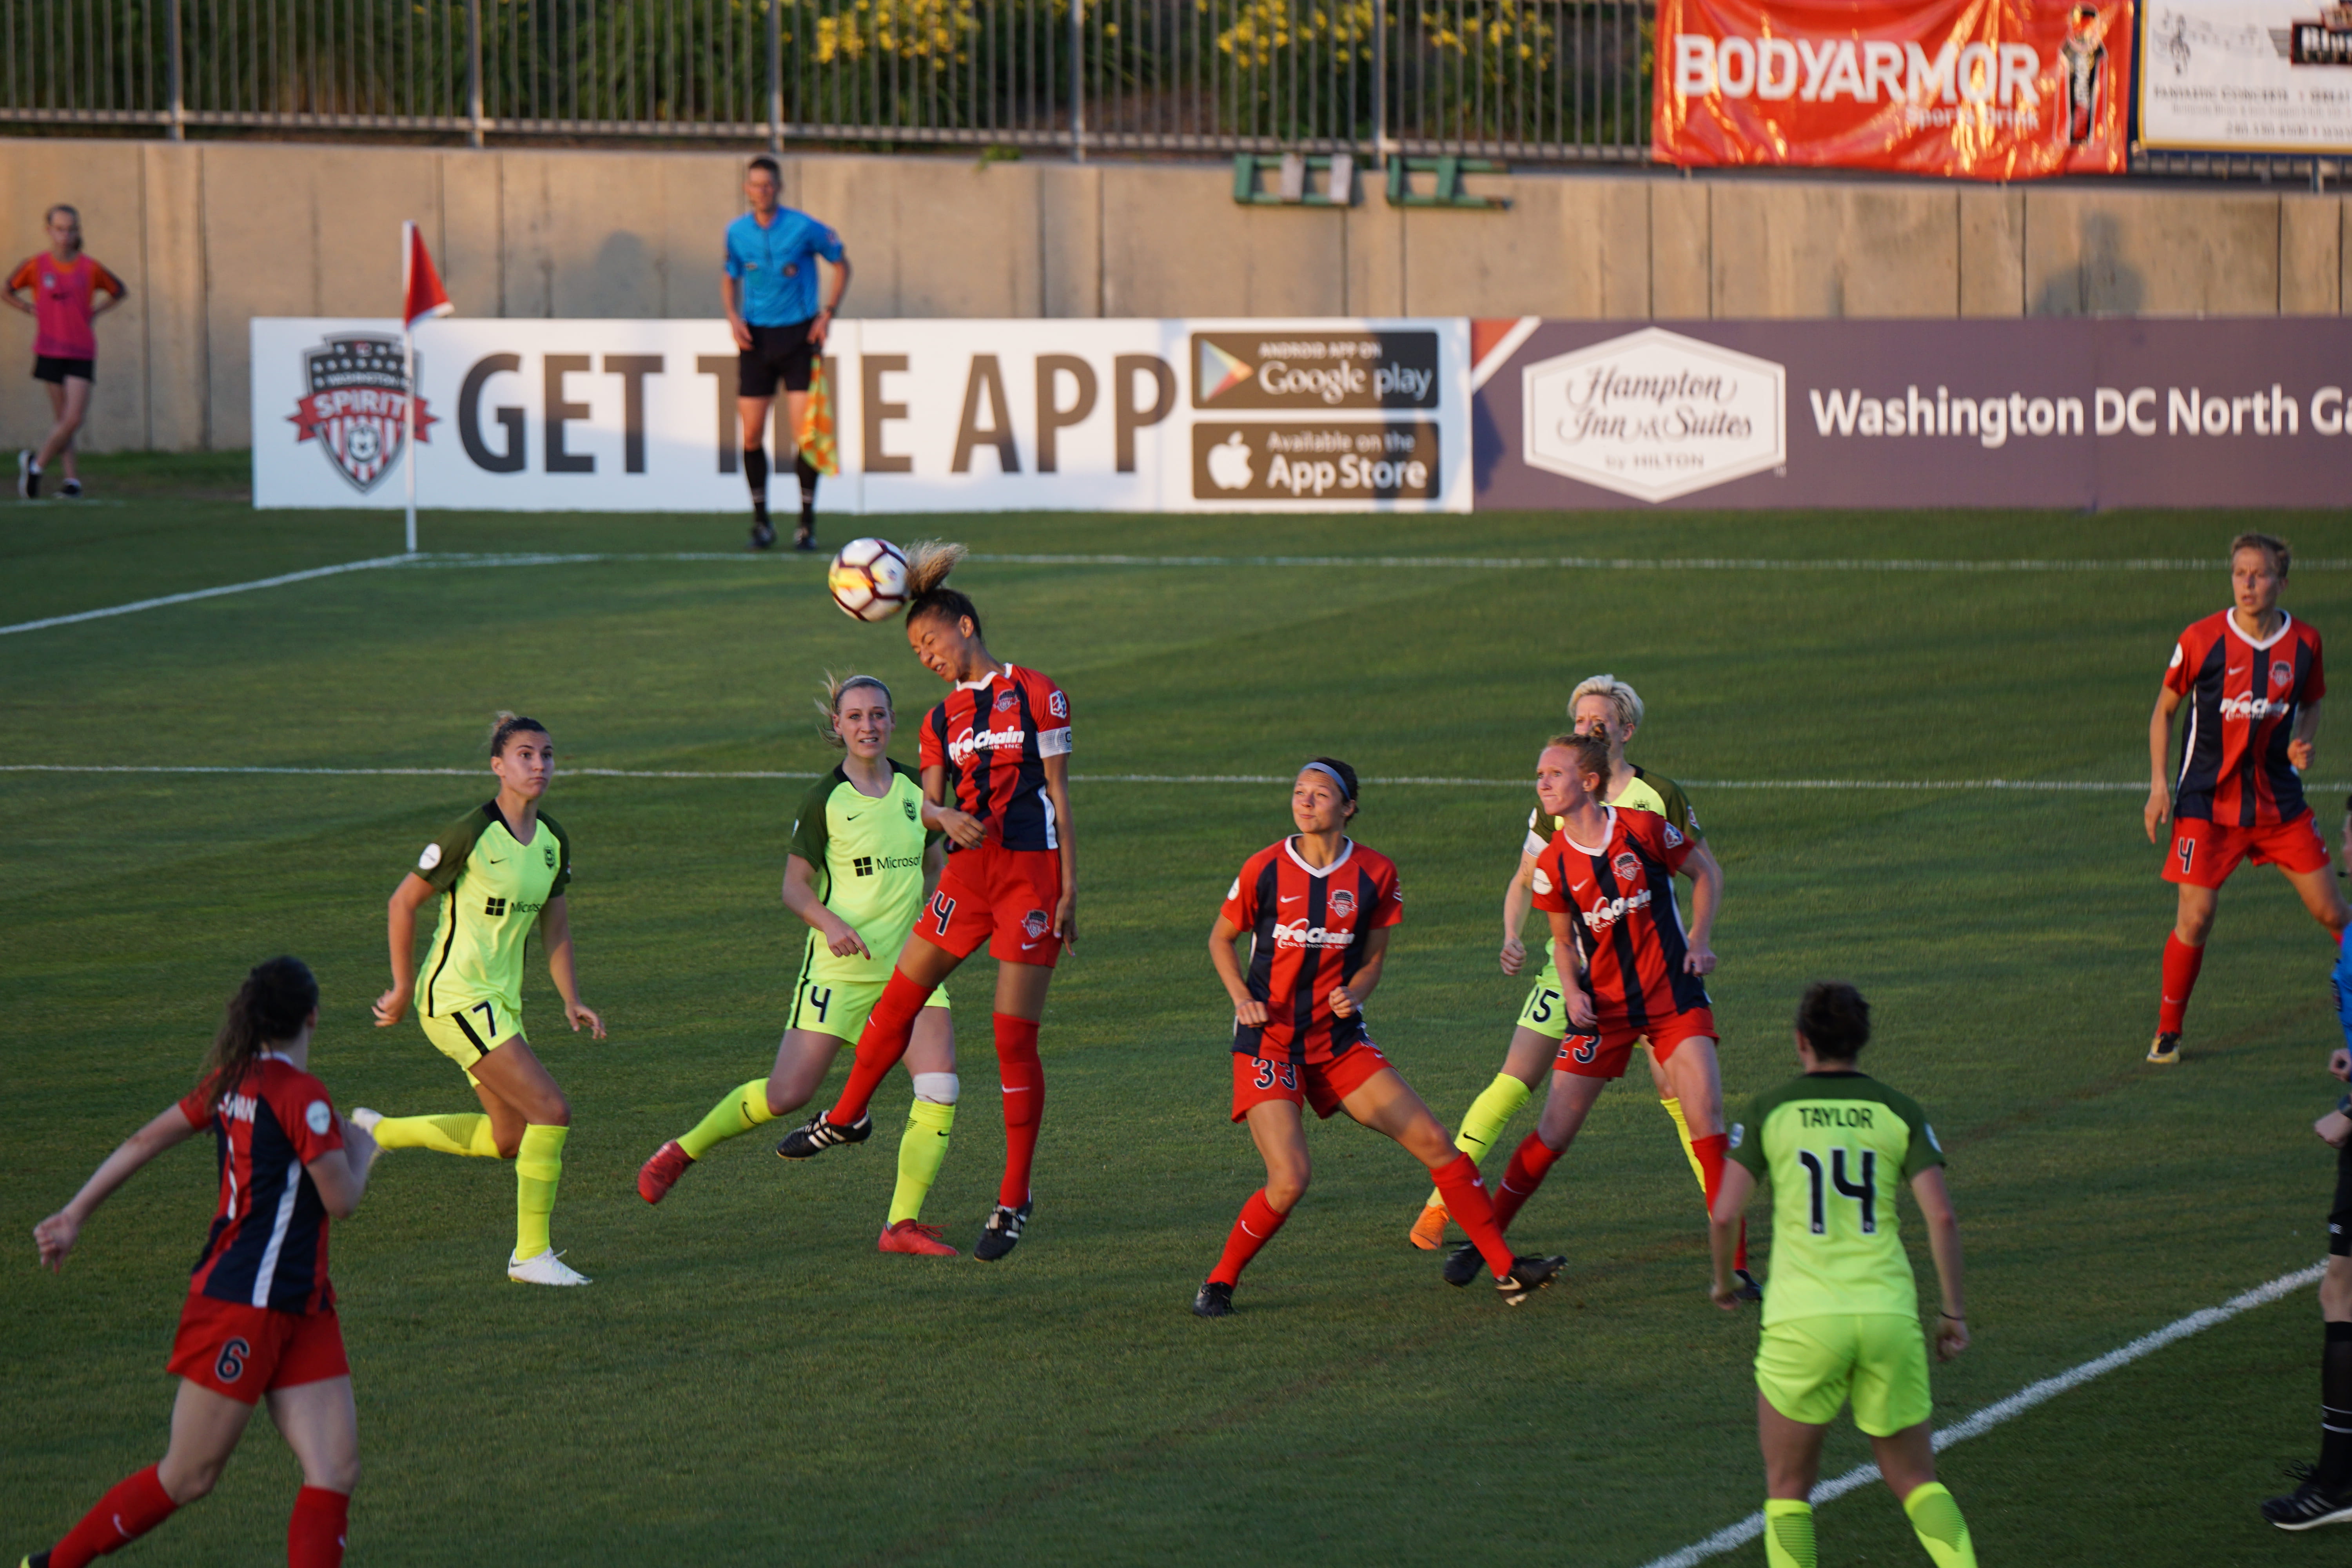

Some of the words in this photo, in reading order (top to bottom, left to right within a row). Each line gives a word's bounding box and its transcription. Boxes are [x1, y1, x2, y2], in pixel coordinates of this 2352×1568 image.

[1674, 34, 2040, 105] BODYARMOR
[1258, 341, 1325, 359] ANDROID
[1329, 341, 1356, 359] APP
[1359, 341, 1383, 359] ON
[1258, 359, 1366, 404] Google
[1373, 361, 1433, 401] play
[1566, 365, 1737, 412] Hampton
[314, 389, 407, 418] SPIRIT
[457, 352, 665, 475] GET
[951, 352, 1179, 474] APP
[1809, 385, 2084, 448] Washington
[2095, 387, 2156, 436] DC
[2168, 384, 2299, 436] North
[1266, 431, 1351, 452] Available
[1355, 435, 1381, 452] on
[1385, 431, 1416, 452] the
[1556, 407, 1642, 445] Inn
[1644, 414, 1663, 443] &
[1663, 403, 1752, 442] Suites
[1266, 453, 1336, 496] App
[1339, 453, 1428, 489] Store
[1605, 453, 1626, 469] by
[1632, 452, 1704, 467] HILTON
[949, 725, 1025, 766] ProChain
[2178, 837, 2195, 874] 4
[918, 891, 956, 936] 4
[1272, 918, 1355, 949] ProChain
[472, 1000, 496, 1038] 7
[810, 985, 831, 1023] 4
[1523, 986, 1560, 1023] 15
[1251, 1057, 1298, 1091] 33
[1797, 1107, 1875, 1129] TAYLOR
[1798, 1147, 1877, 1235] 14
[215, 1336, 250, 1383] 6
